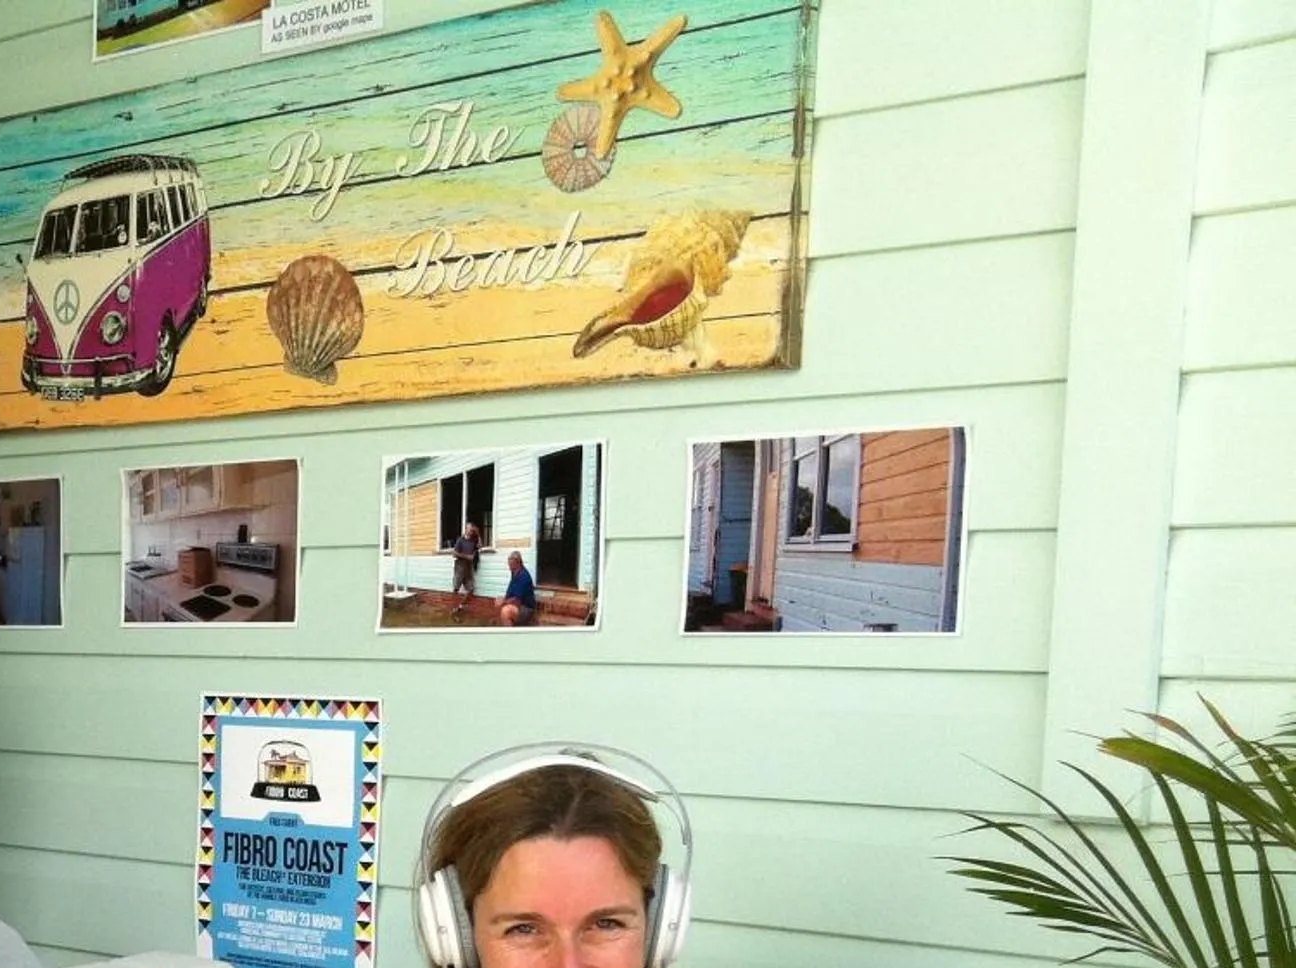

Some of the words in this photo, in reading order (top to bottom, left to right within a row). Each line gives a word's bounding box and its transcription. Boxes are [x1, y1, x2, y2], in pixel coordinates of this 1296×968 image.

[272, 15, 288, 30] LA
[289, 7, 329, 25] COSTA
[331, 0, 371, 15] MOTEL
[271, 31, 283, 43] AS
[285, 27, 308, 40] SEEN
[310, 23, 322, 35] BY
[259, 127, 364, 222] By
[395, 100, 524, 177] The
[387, 210, 604, 299] Beach
[222, 831, 278, 868] FIBRO
[282, 837, 349, 876] COAST
[236, 865, 251, 881] THE
[288, 872, 331, 889] EXTENSION
[266, 907, 298, 926] SUNDAY
[311, 914, 344, 931] MARCH
